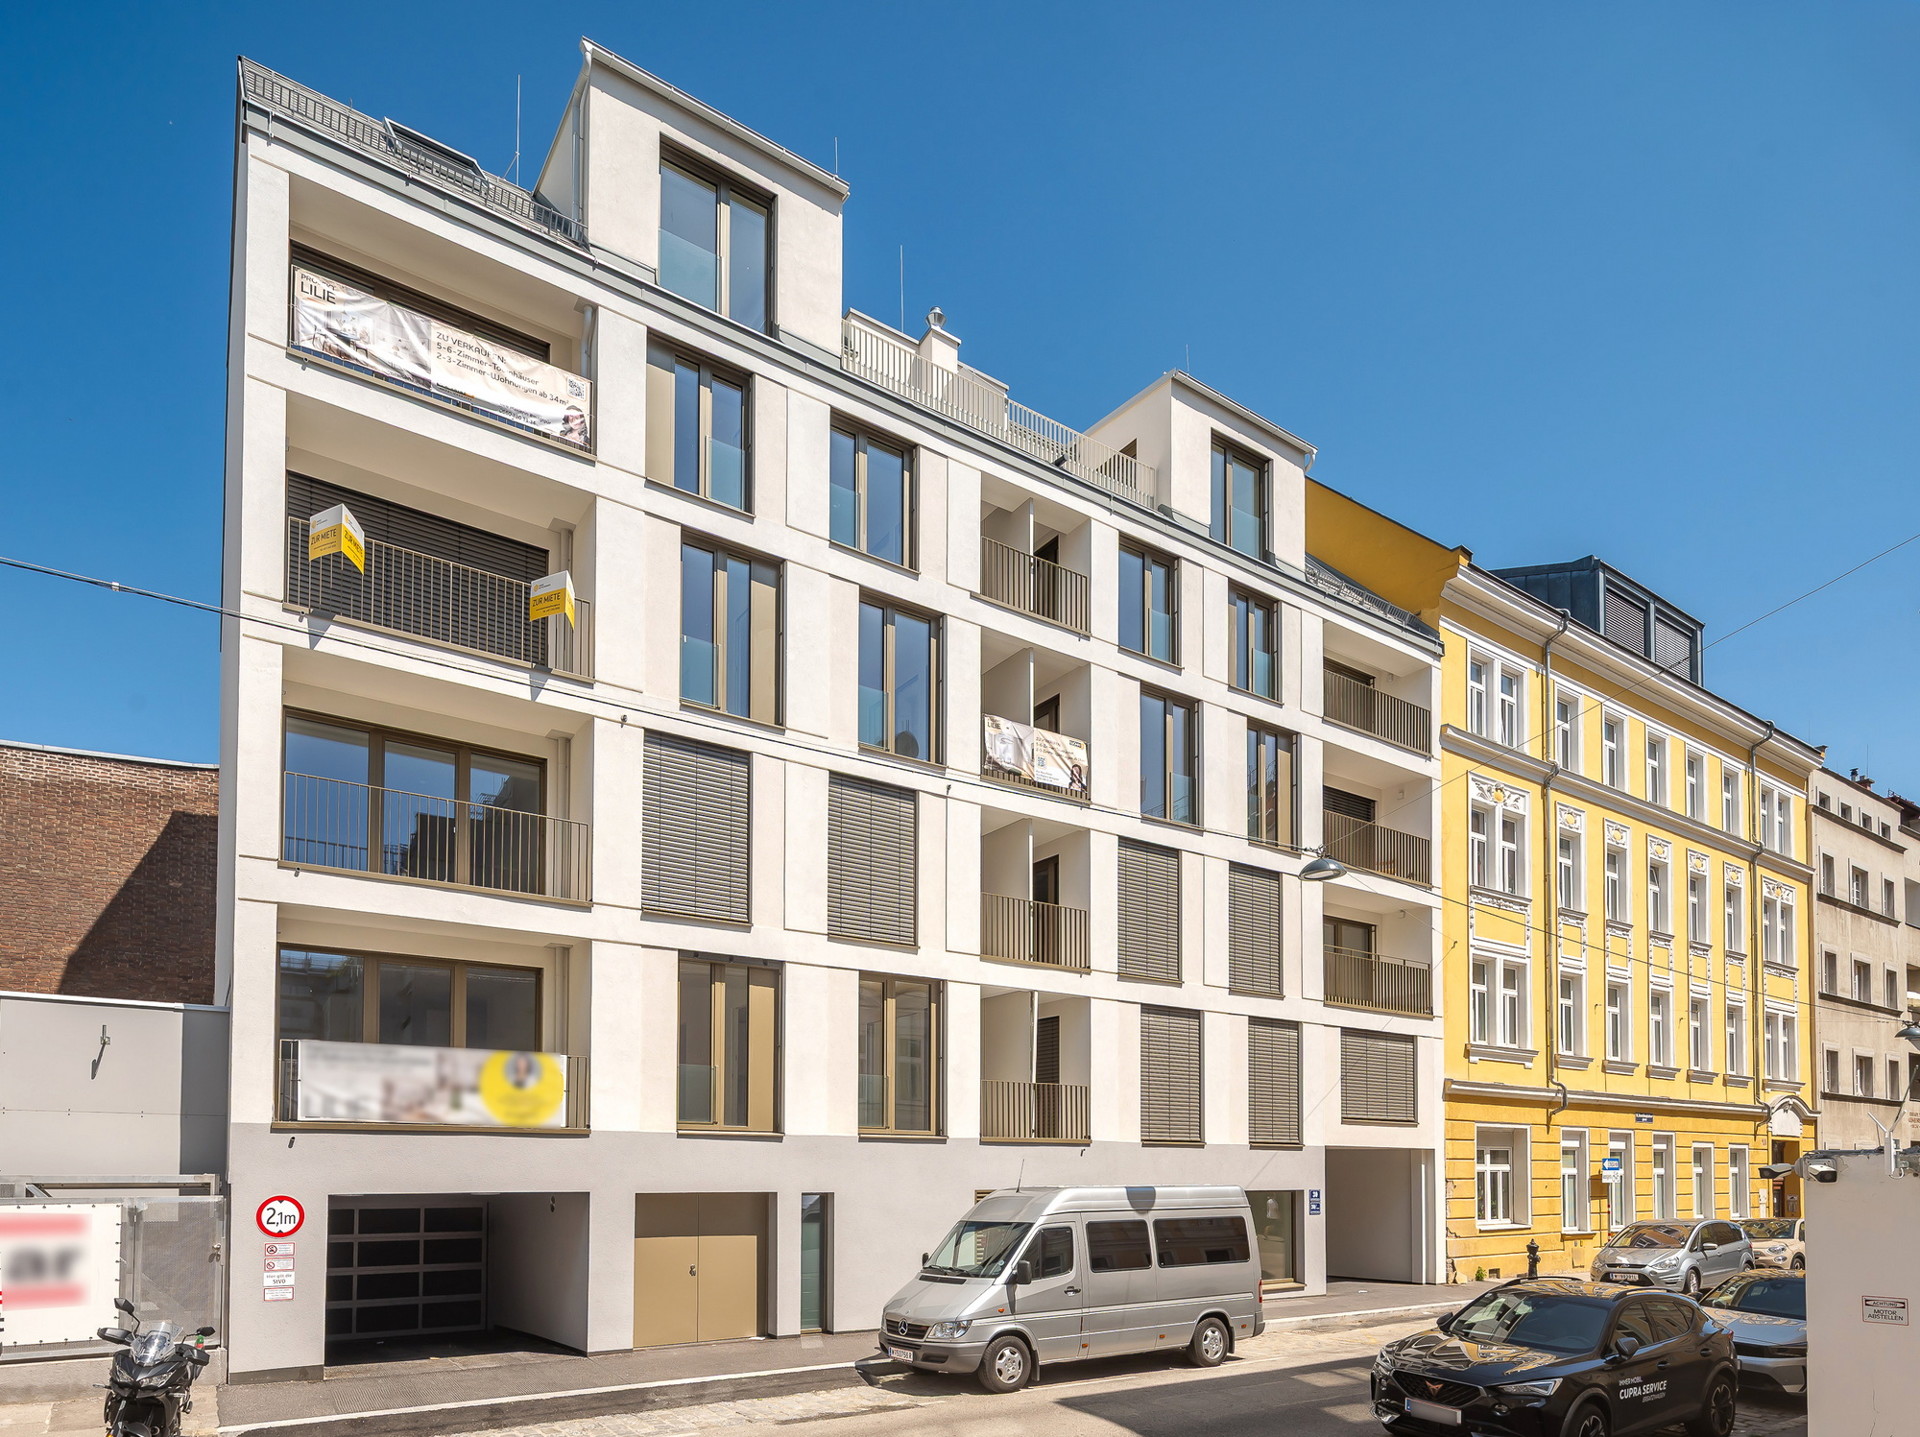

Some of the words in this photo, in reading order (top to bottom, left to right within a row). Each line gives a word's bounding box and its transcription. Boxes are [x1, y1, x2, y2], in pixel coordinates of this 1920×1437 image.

[300, 281, 336, 305] LILIE
[436, 331, 449, 342] ZU
[451, 336, 507, 364] VERKAUFN:
[436, 342, 540, 386] 5-6-Zimmer-Tonhäuser
[538, 389, 548, 399] ab
[311, 534, 321, 546] ZUR
[321, 528, 337, 541] MIETE
[532, 597, 544, 607] ZUR
[543, 592, 561, 604] MIETE
[266, 1207, 296, 1227] 2,1m
[1867, 1313, 1904, 1321] ABSTELLEN
[1619, 1386, 1642, 1400] CUPRA
[1642, 1380, 1668, 1395] SERVICE
